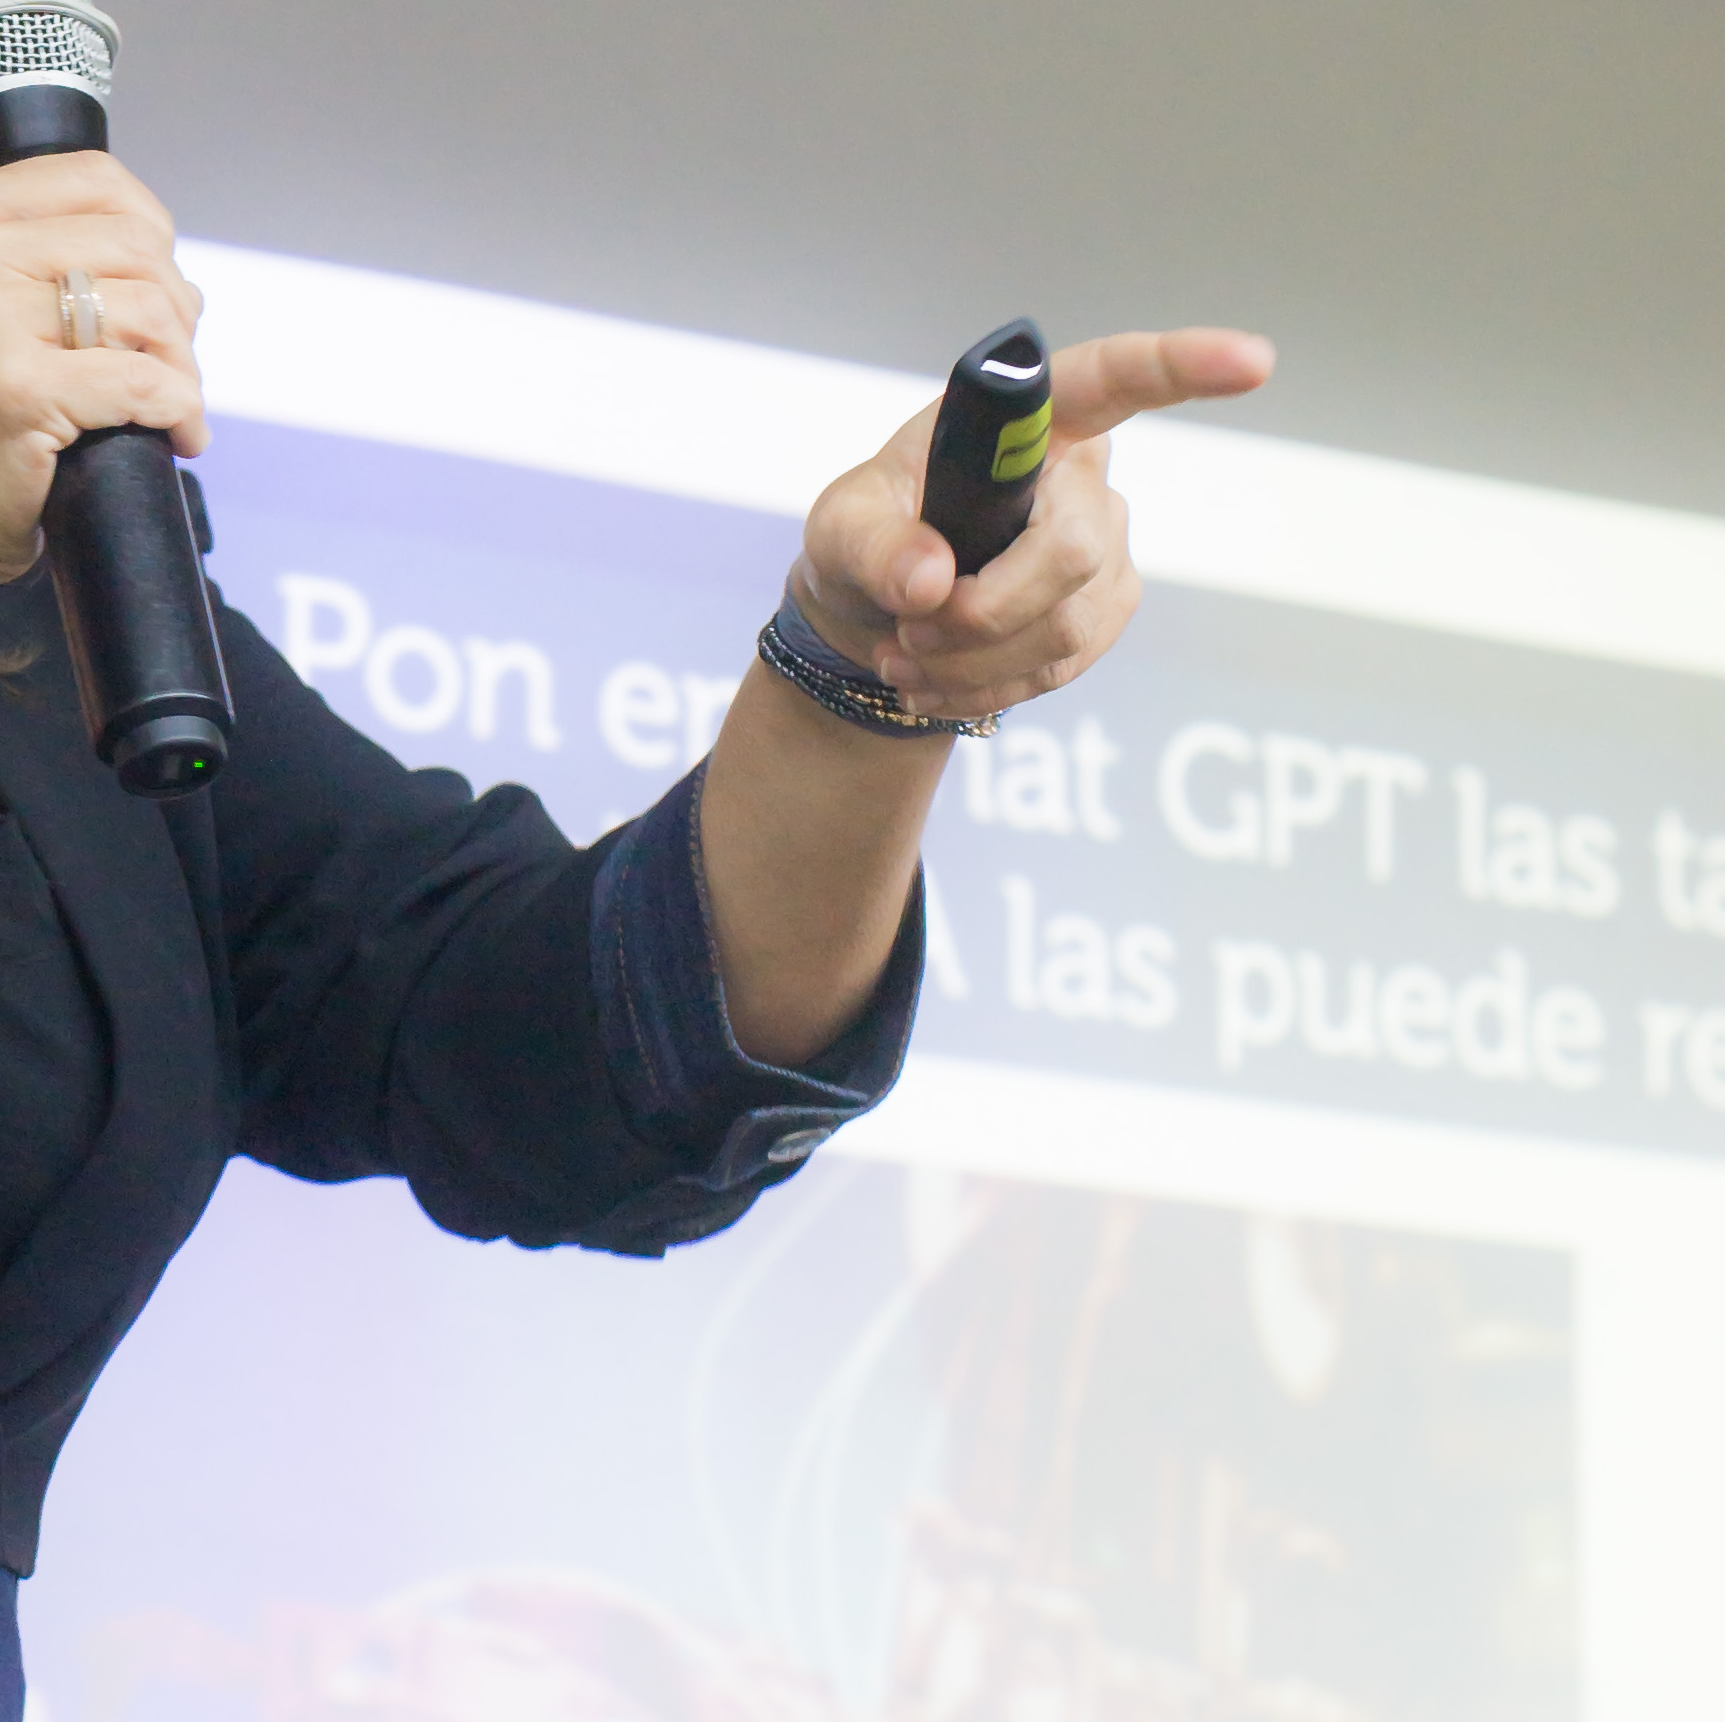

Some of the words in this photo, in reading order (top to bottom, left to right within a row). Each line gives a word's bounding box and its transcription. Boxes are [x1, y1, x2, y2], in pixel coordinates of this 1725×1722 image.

[278, 574, 562, 754] Pon
[1157, 719, 1427, 885] GPT
[1449, 762, 1621, 922] las
[1000, 874, 1178, 1031] las
[1212, 935, 1606, 1093] puede
